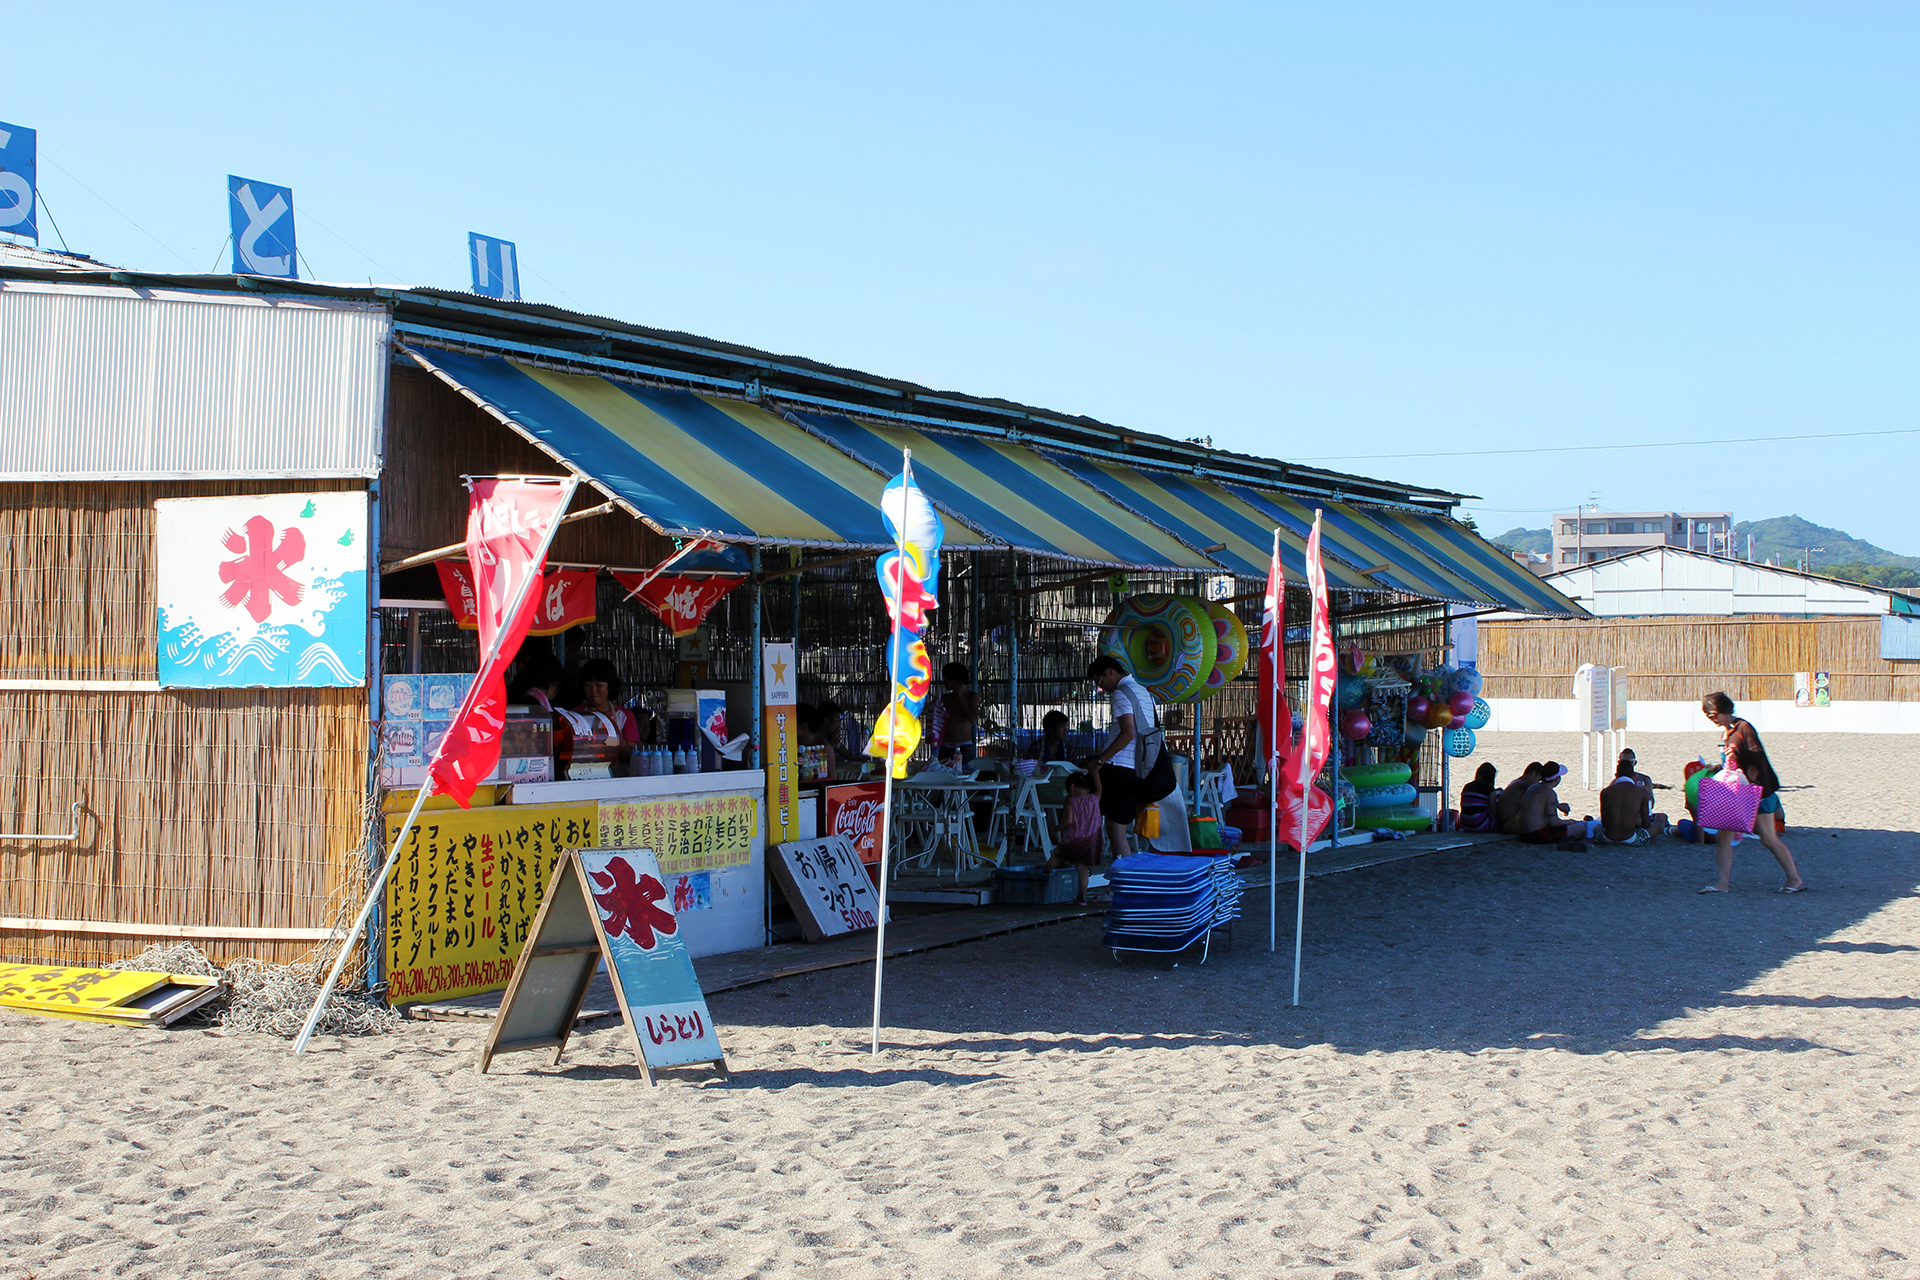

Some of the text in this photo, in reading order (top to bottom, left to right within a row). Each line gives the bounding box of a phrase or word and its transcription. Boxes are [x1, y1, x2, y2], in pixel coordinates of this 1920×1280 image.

[218, 515, 306, 623] 氷
[770, 691, 789, 700] SAPPORO
[776, 712, 790, 843] サッポロ生ビー
[692, 818, 703, 854] カンロ
[716, 815, 725, 850] レモン
[727, 814, 737, 849] メロン
[739, 813, 749, 848] いちご
[834, 800, 878, 836] Coca-Cola
[667, 820, 677, 855] ミルク
[680, 819, 691, 855] 宇治
[861, 835, 875, 850] Coke
[794, 841, 857, 880] お帰り
[408, 825, 422, 967] アメリカンドッグ
[428, 825, 440, 959] フランクフルト
[445, 838, 460, 949] えだまめ
[462, 833, 478, 948] やきとり
[481, 834, 496, 939] 生ビール
[498, 829, 514, 956] いかの丸やき
[515, 825, 531, 944] やきそば
[818, 883, 867, 912] シャワー
[589, 857, 678, 950] 氷
[840, 907, 877, 931] 500円
[645, 1010, 704, 1045] しらとり
